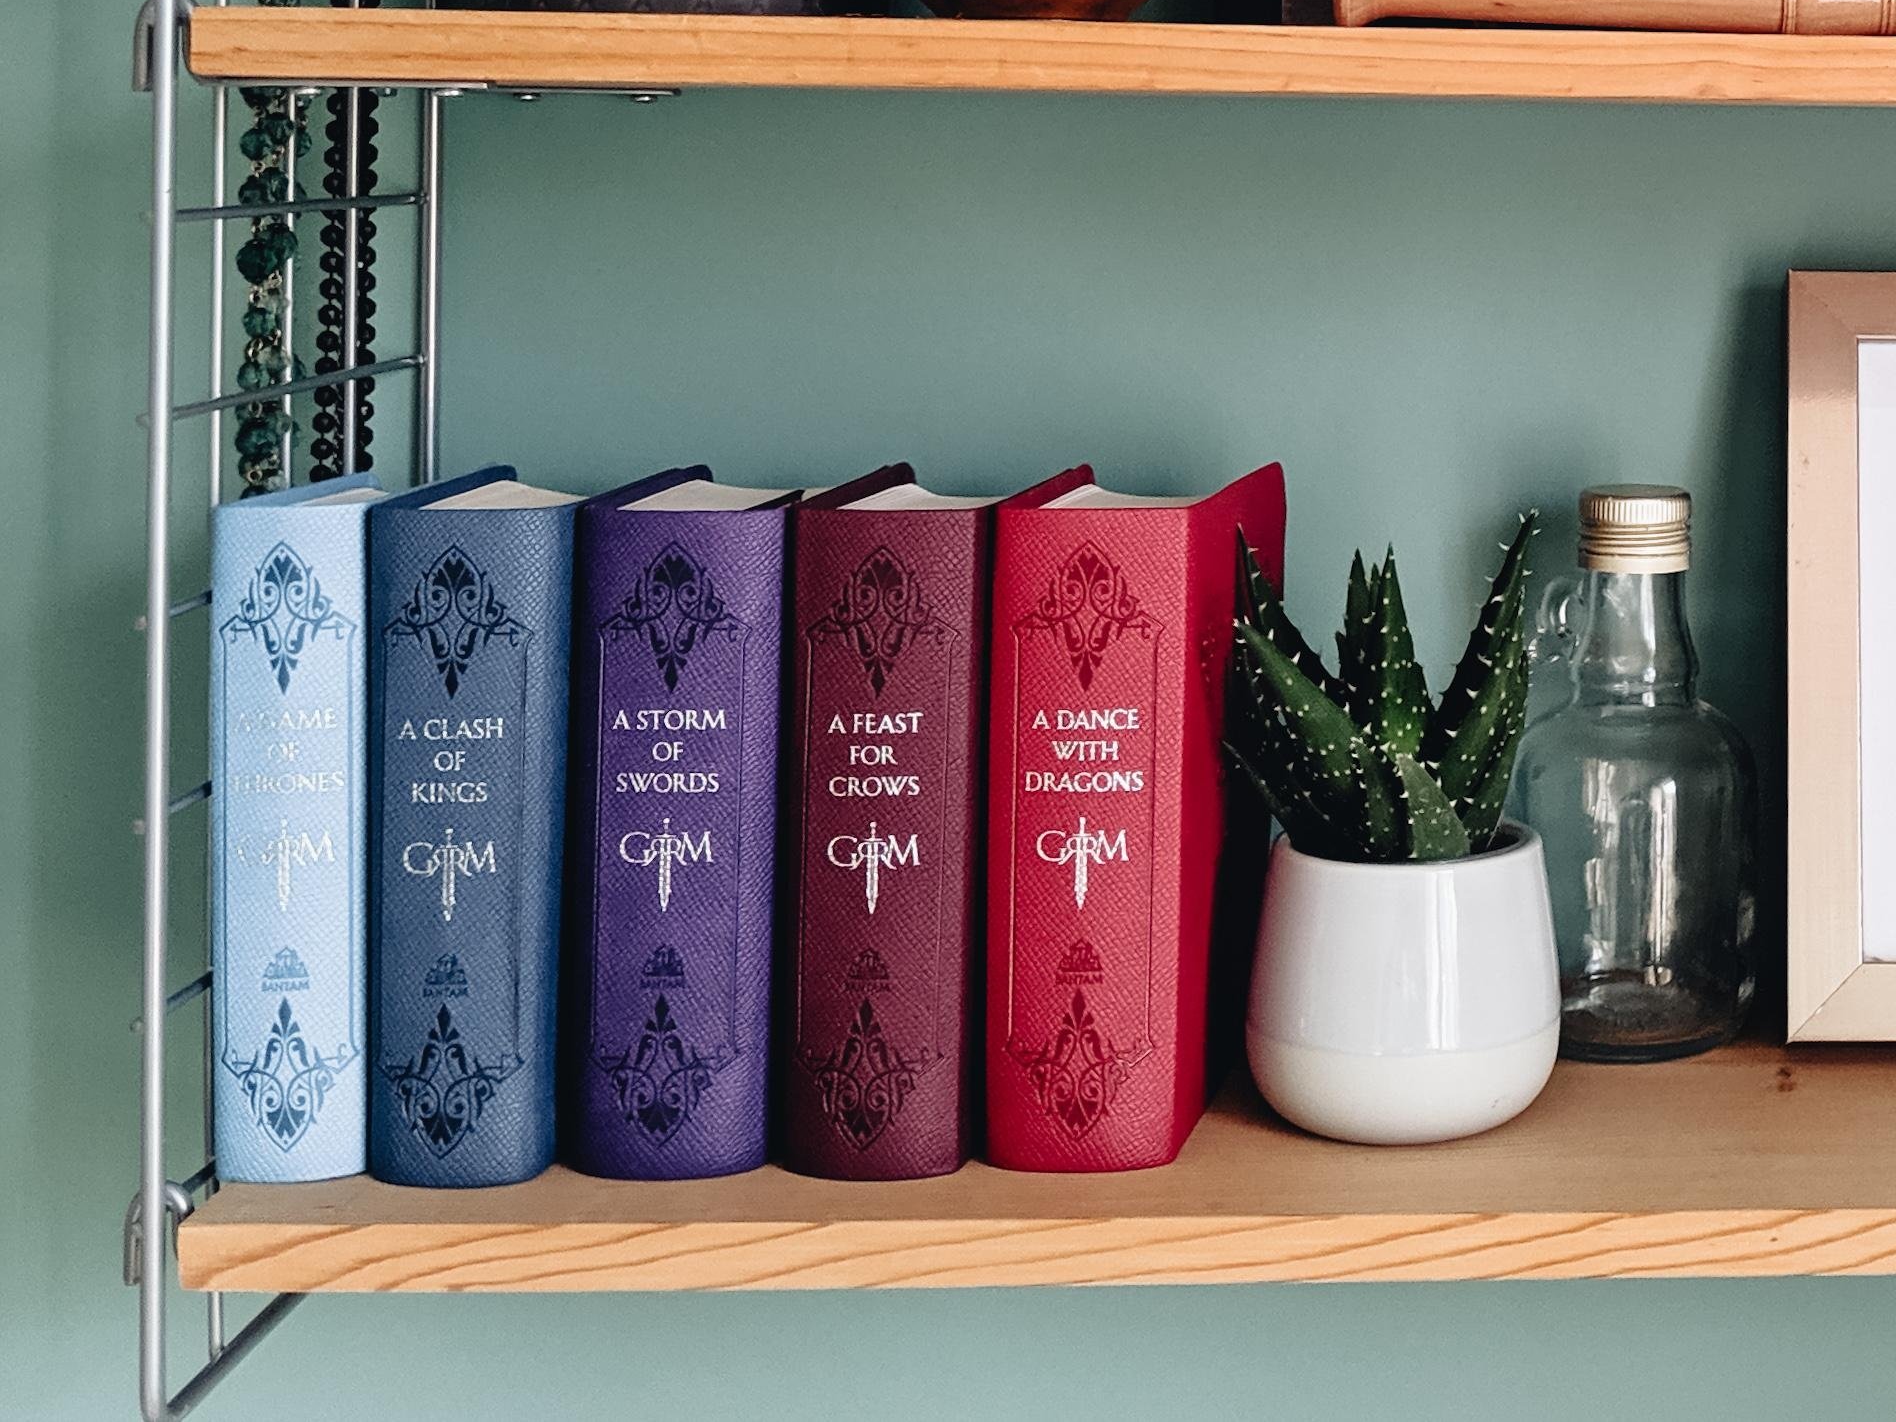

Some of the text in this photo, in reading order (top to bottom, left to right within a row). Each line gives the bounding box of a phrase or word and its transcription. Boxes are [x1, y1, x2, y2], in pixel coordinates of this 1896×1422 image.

[399, 717, 503, 740] A CLASH
[613, 709, 726, 732] A STORM
[828, 712, 923, 735] A FEAST
[1032, 708, 1140, 731] A DANCE
[434, 751, 466, 772] OF
[652, 741, 684, 762] OF
[849, 744, 898, 765] FOR
[1052, 740, 1120, 762] WITH
[411, 782, 488, 804] KINGS
[616, 772, 720, 795] SWORDS
[828, 776, 920, 797] CROWS
[1025, 771, 1144, 793] DRAGONS
